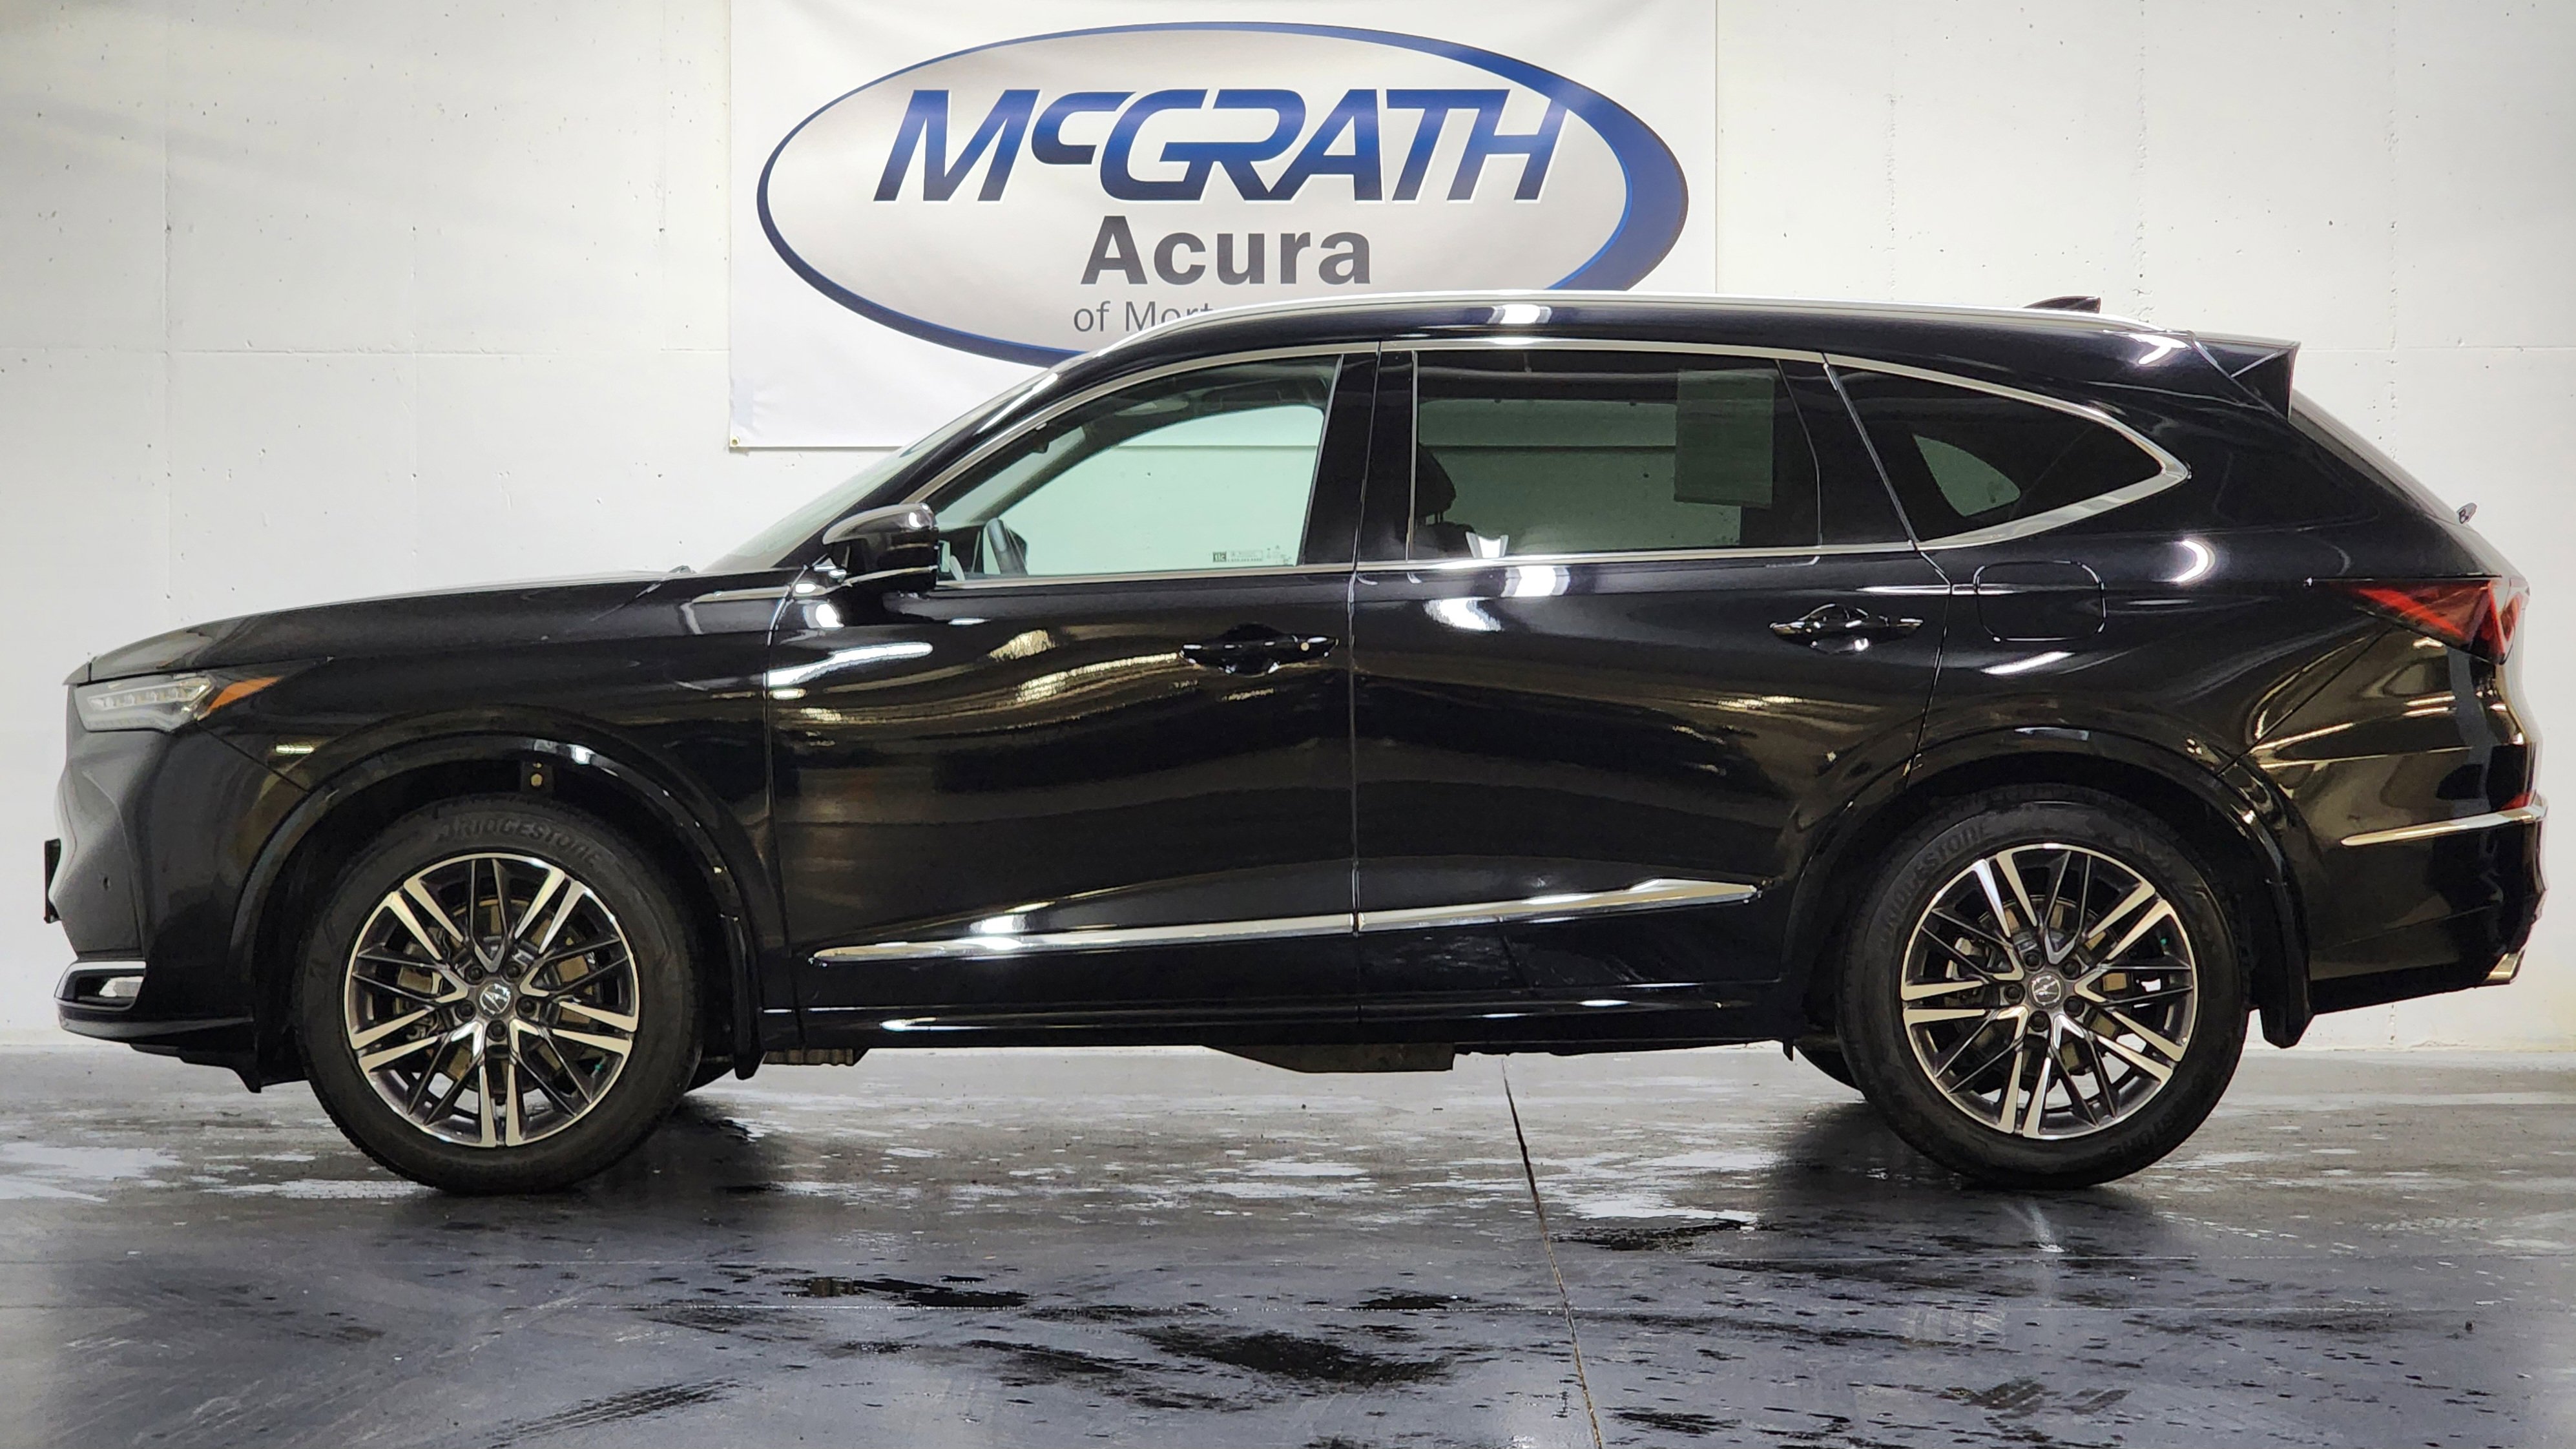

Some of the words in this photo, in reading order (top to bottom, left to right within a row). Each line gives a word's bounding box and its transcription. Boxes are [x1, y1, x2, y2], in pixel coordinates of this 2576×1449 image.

[873, 89, 1566, 202] McGRATH
[1080, 215, 1371, 286] Acura
[1074, 300, 1111, 332] of
